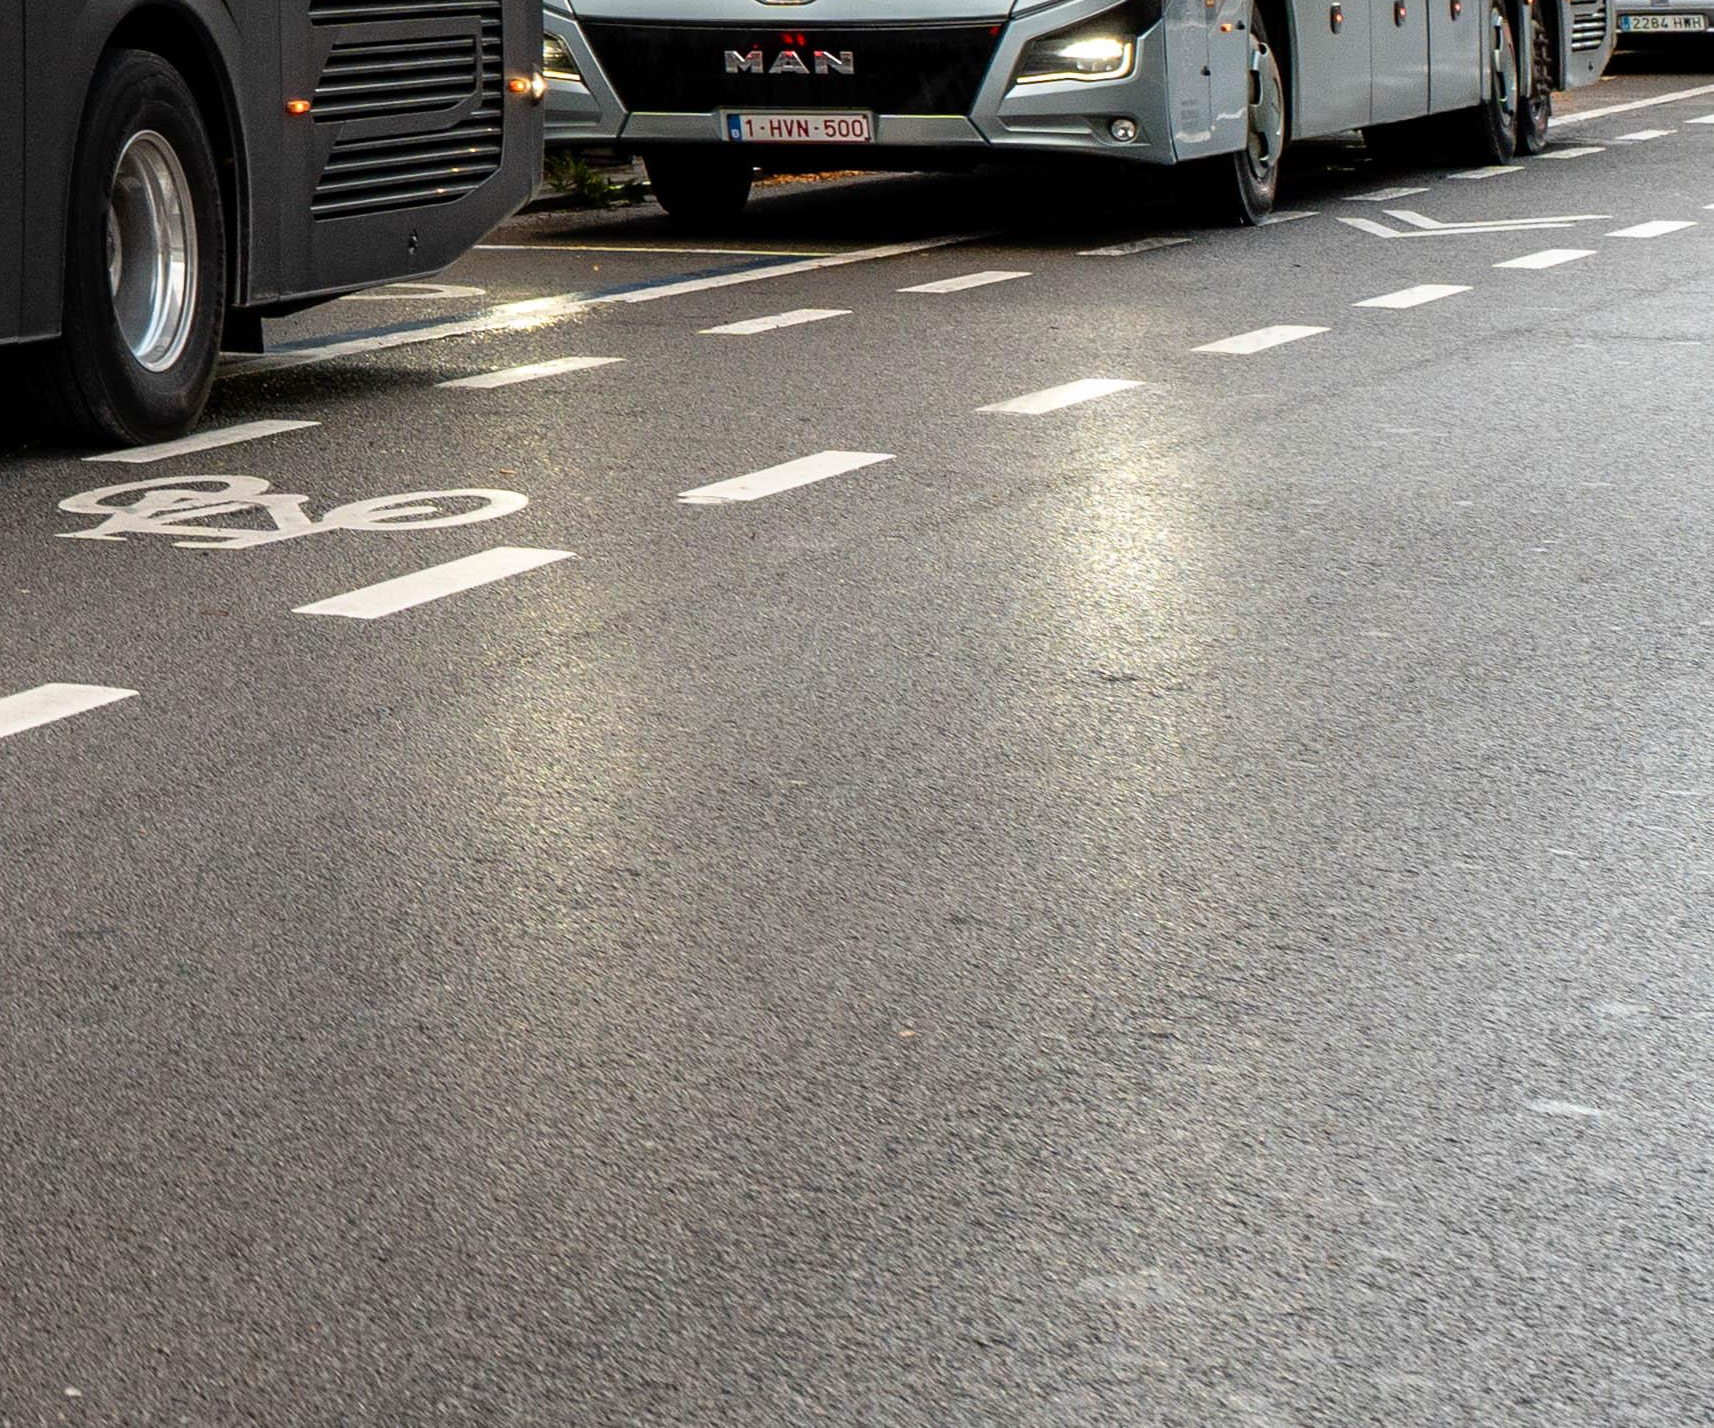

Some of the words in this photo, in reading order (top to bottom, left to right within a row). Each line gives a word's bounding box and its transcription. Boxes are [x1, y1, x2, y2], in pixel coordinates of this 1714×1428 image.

[1633, 17, 1668, 29] 2284
[724, 50, 855, 75] MAN
[744, 119, 864, 137] 1-HVN-500
